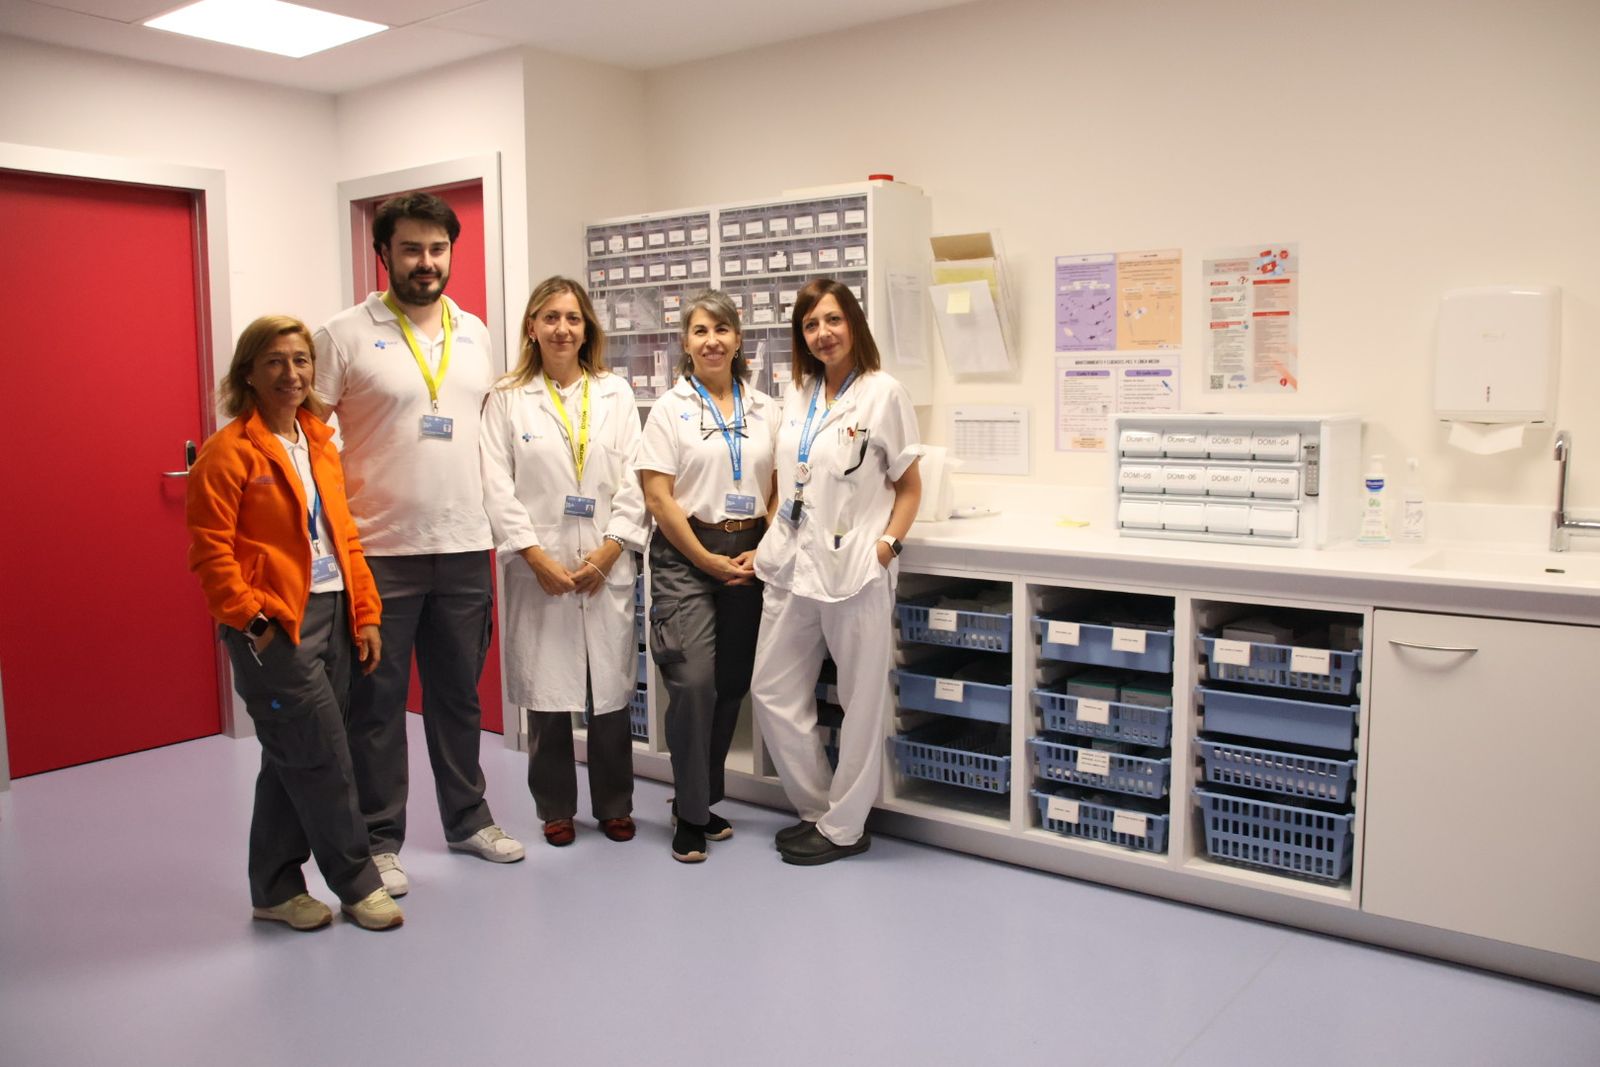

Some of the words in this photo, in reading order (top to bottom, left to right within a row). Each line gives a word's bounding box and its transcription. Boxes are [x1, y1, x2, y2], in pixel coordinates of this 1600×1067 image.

[1211, 437, 1242, 446] DOMI-03
[1257, 438, 1289, 446] DOMI-04
[1123, 472, 1151, 480] DOMI-05
[1166, 473, 1197, 481] DOMI-06
[1211, 474, 1242, 483] DOMI-07
[1257, 476, 1289, 485] DOMI-08
